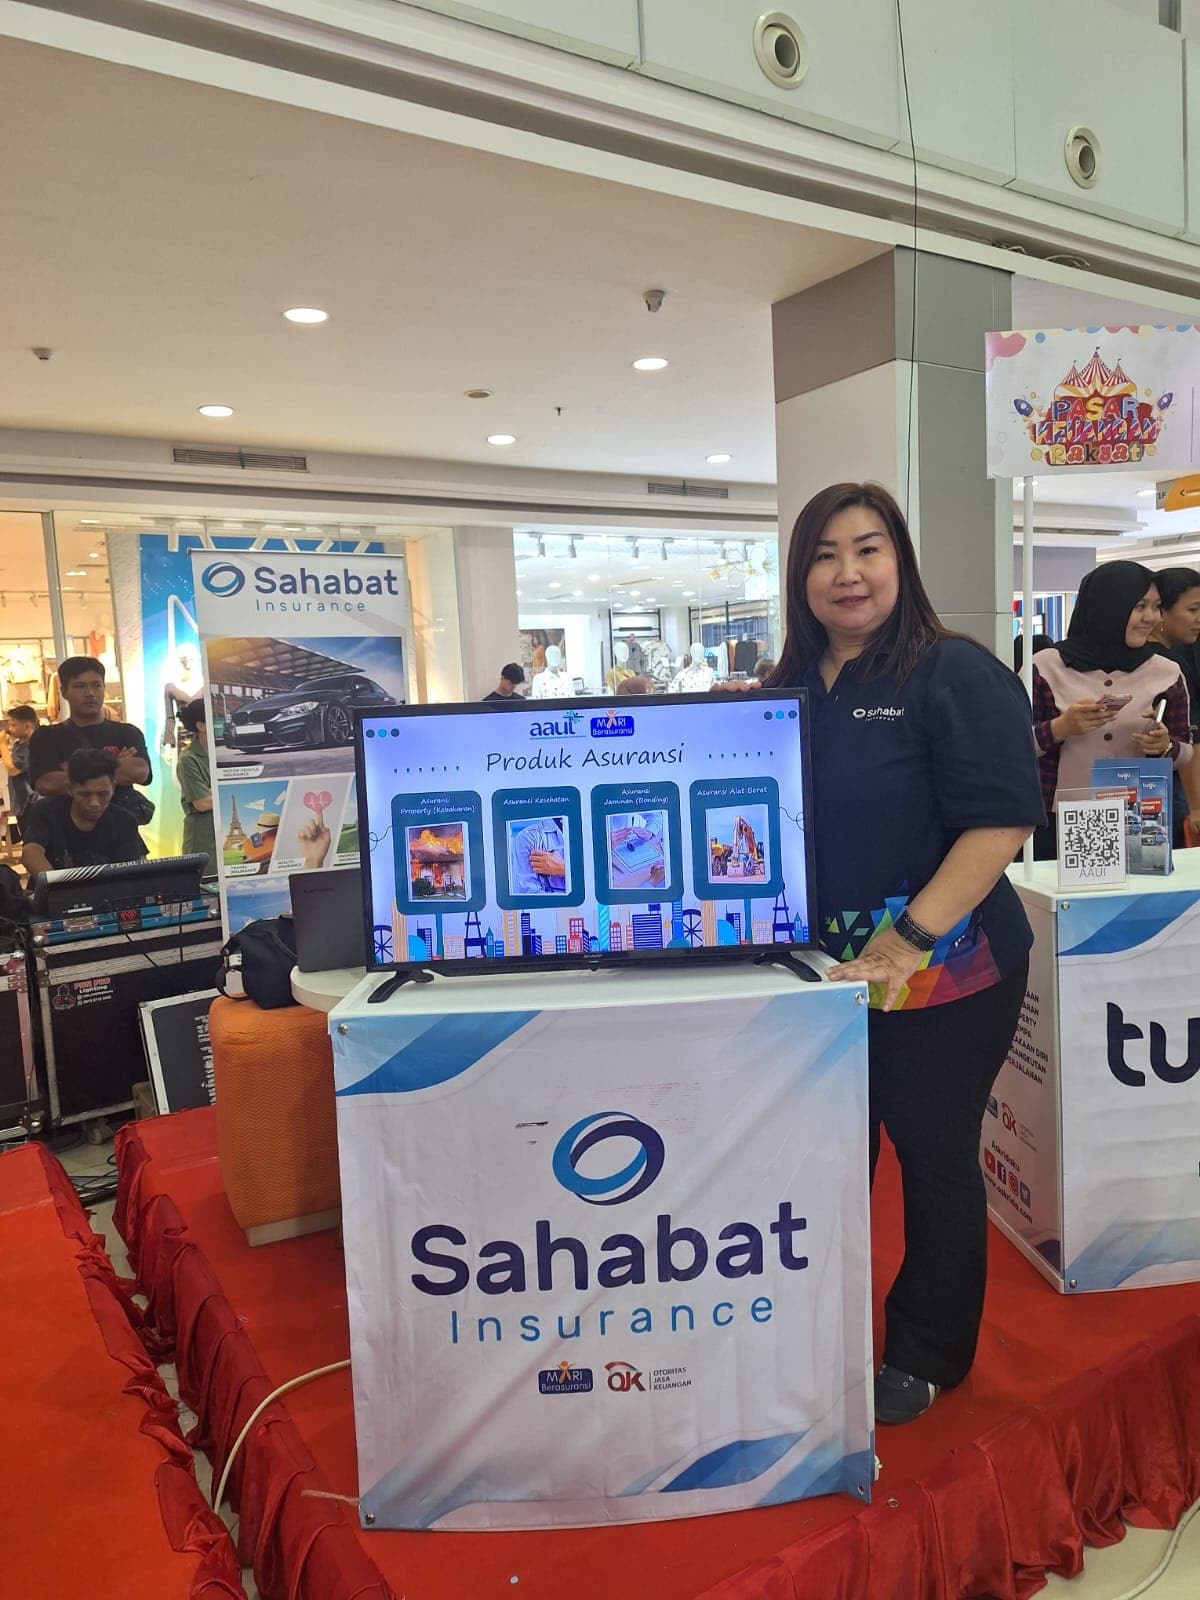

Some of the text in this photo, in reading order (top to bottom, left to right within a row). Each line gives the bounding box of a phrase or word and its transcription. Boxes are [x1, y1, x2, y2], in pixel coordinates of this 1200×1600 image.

[1050, 396, 1140, 421] PASAR
[1049, 443, 1145, 465] Rakyat
[254, 566, 399, 595] Sahabat
[256, 599, 366, 612] Insurance
[486, 743, 685, 772] Produk Asuransi
[622, 786, 651, 796] Asuransi
[697, 788, 728, 796] Asuransi
[420, 797, 451, 805] Asuransi
[503, 798, 534, 806] Asuransi
[400, 805, 476, 816] Property (Kebakaran)
[1079, 867, 1107, 878] AAUI
[1013, 1035, 1034, 1055] AKAAN
[410, 1201, 809, 1296] Sahabat
[451, 1296, 775, 1345] Insurance
[546, 1369, 583, 1384] MARI
[653, 1366, 687, 1376] OTORITAS
[541, 1381, 592, 1392] Berasuransi
[654, 1380, 692, 1391] KEUANGAN
